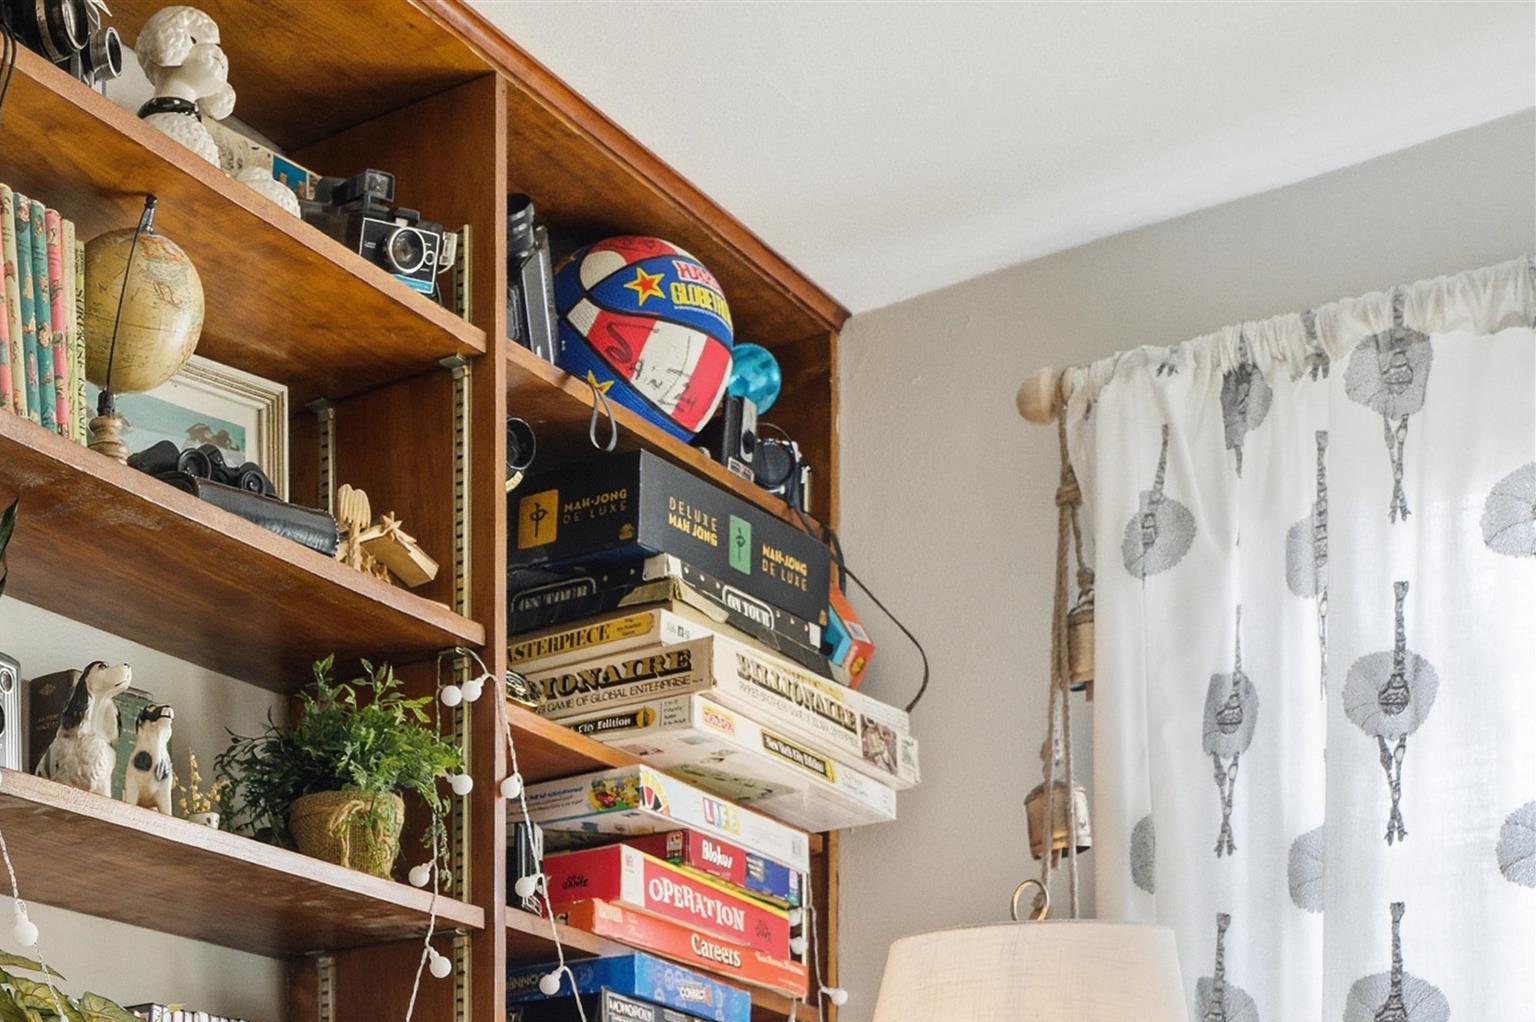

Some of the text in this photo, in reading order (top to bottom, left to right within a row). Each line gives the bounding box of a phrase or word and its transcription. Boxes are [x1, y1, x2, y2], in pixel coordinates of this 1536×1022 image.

[668, 496, 718, 532] DELUXE
[668, 514, 718, 548] MAH JONG
[762, 559, 808, 592] DE LUXE
[507, 622, 613, 664] ASTERPIECE
[541, 649, 693, 701] IONAIRE
[547, 700, 575, 714] GAME
[576, 695, 589, 706] OF
[591, 687, 628, 706] GLOBAL
[630, 674, 691, 697] ENTERPRISE
[736, 652, 858, 736] BILLIONAIRE
[597, 715, 632, 730] Edition
[702, 839, 733, 869] Blokus
[649, 877, 745, 932] OPERATION
[691, 933, 742, 968] Careers
